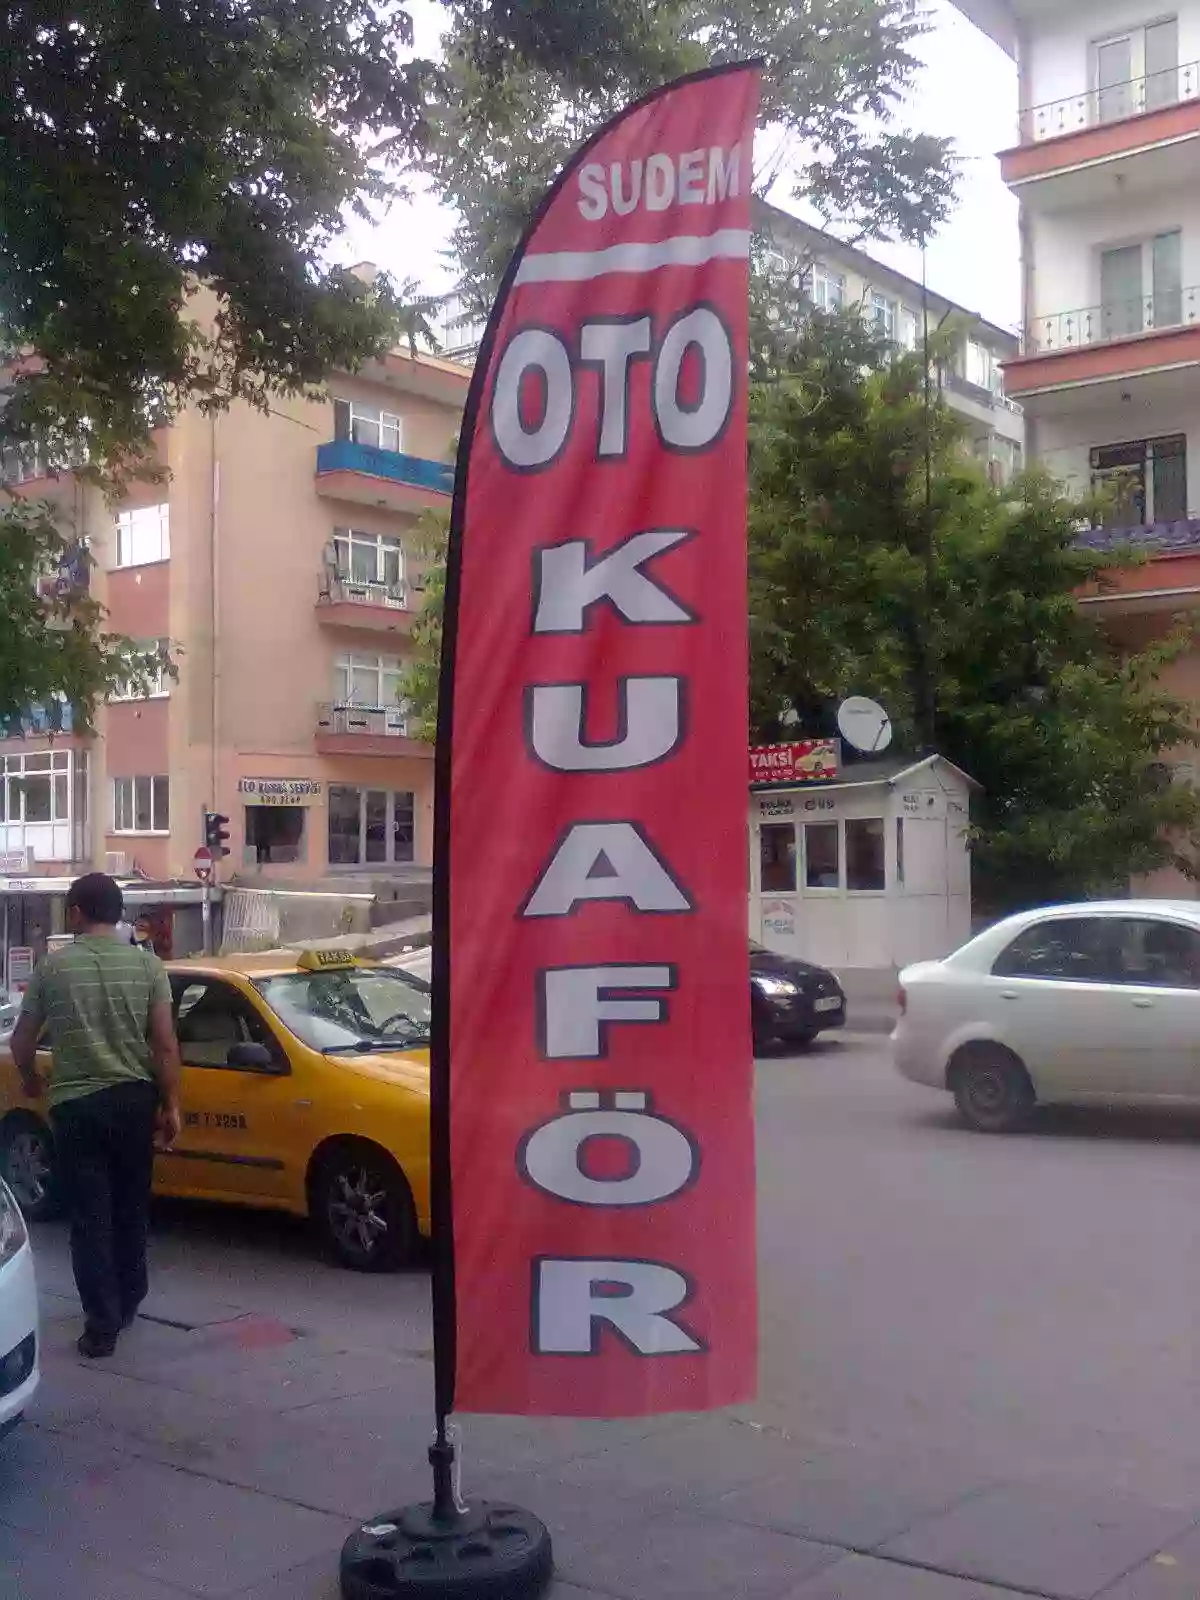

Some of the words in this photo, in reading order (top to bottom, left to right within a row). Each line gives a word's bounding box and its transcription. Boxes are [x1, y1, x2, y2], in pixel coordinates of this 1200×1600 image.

[577, 143, 740, 221] SUDEM
[490, 304, 735, 471] OTO
[516, 529, 707, 1356] KUAFÖR
